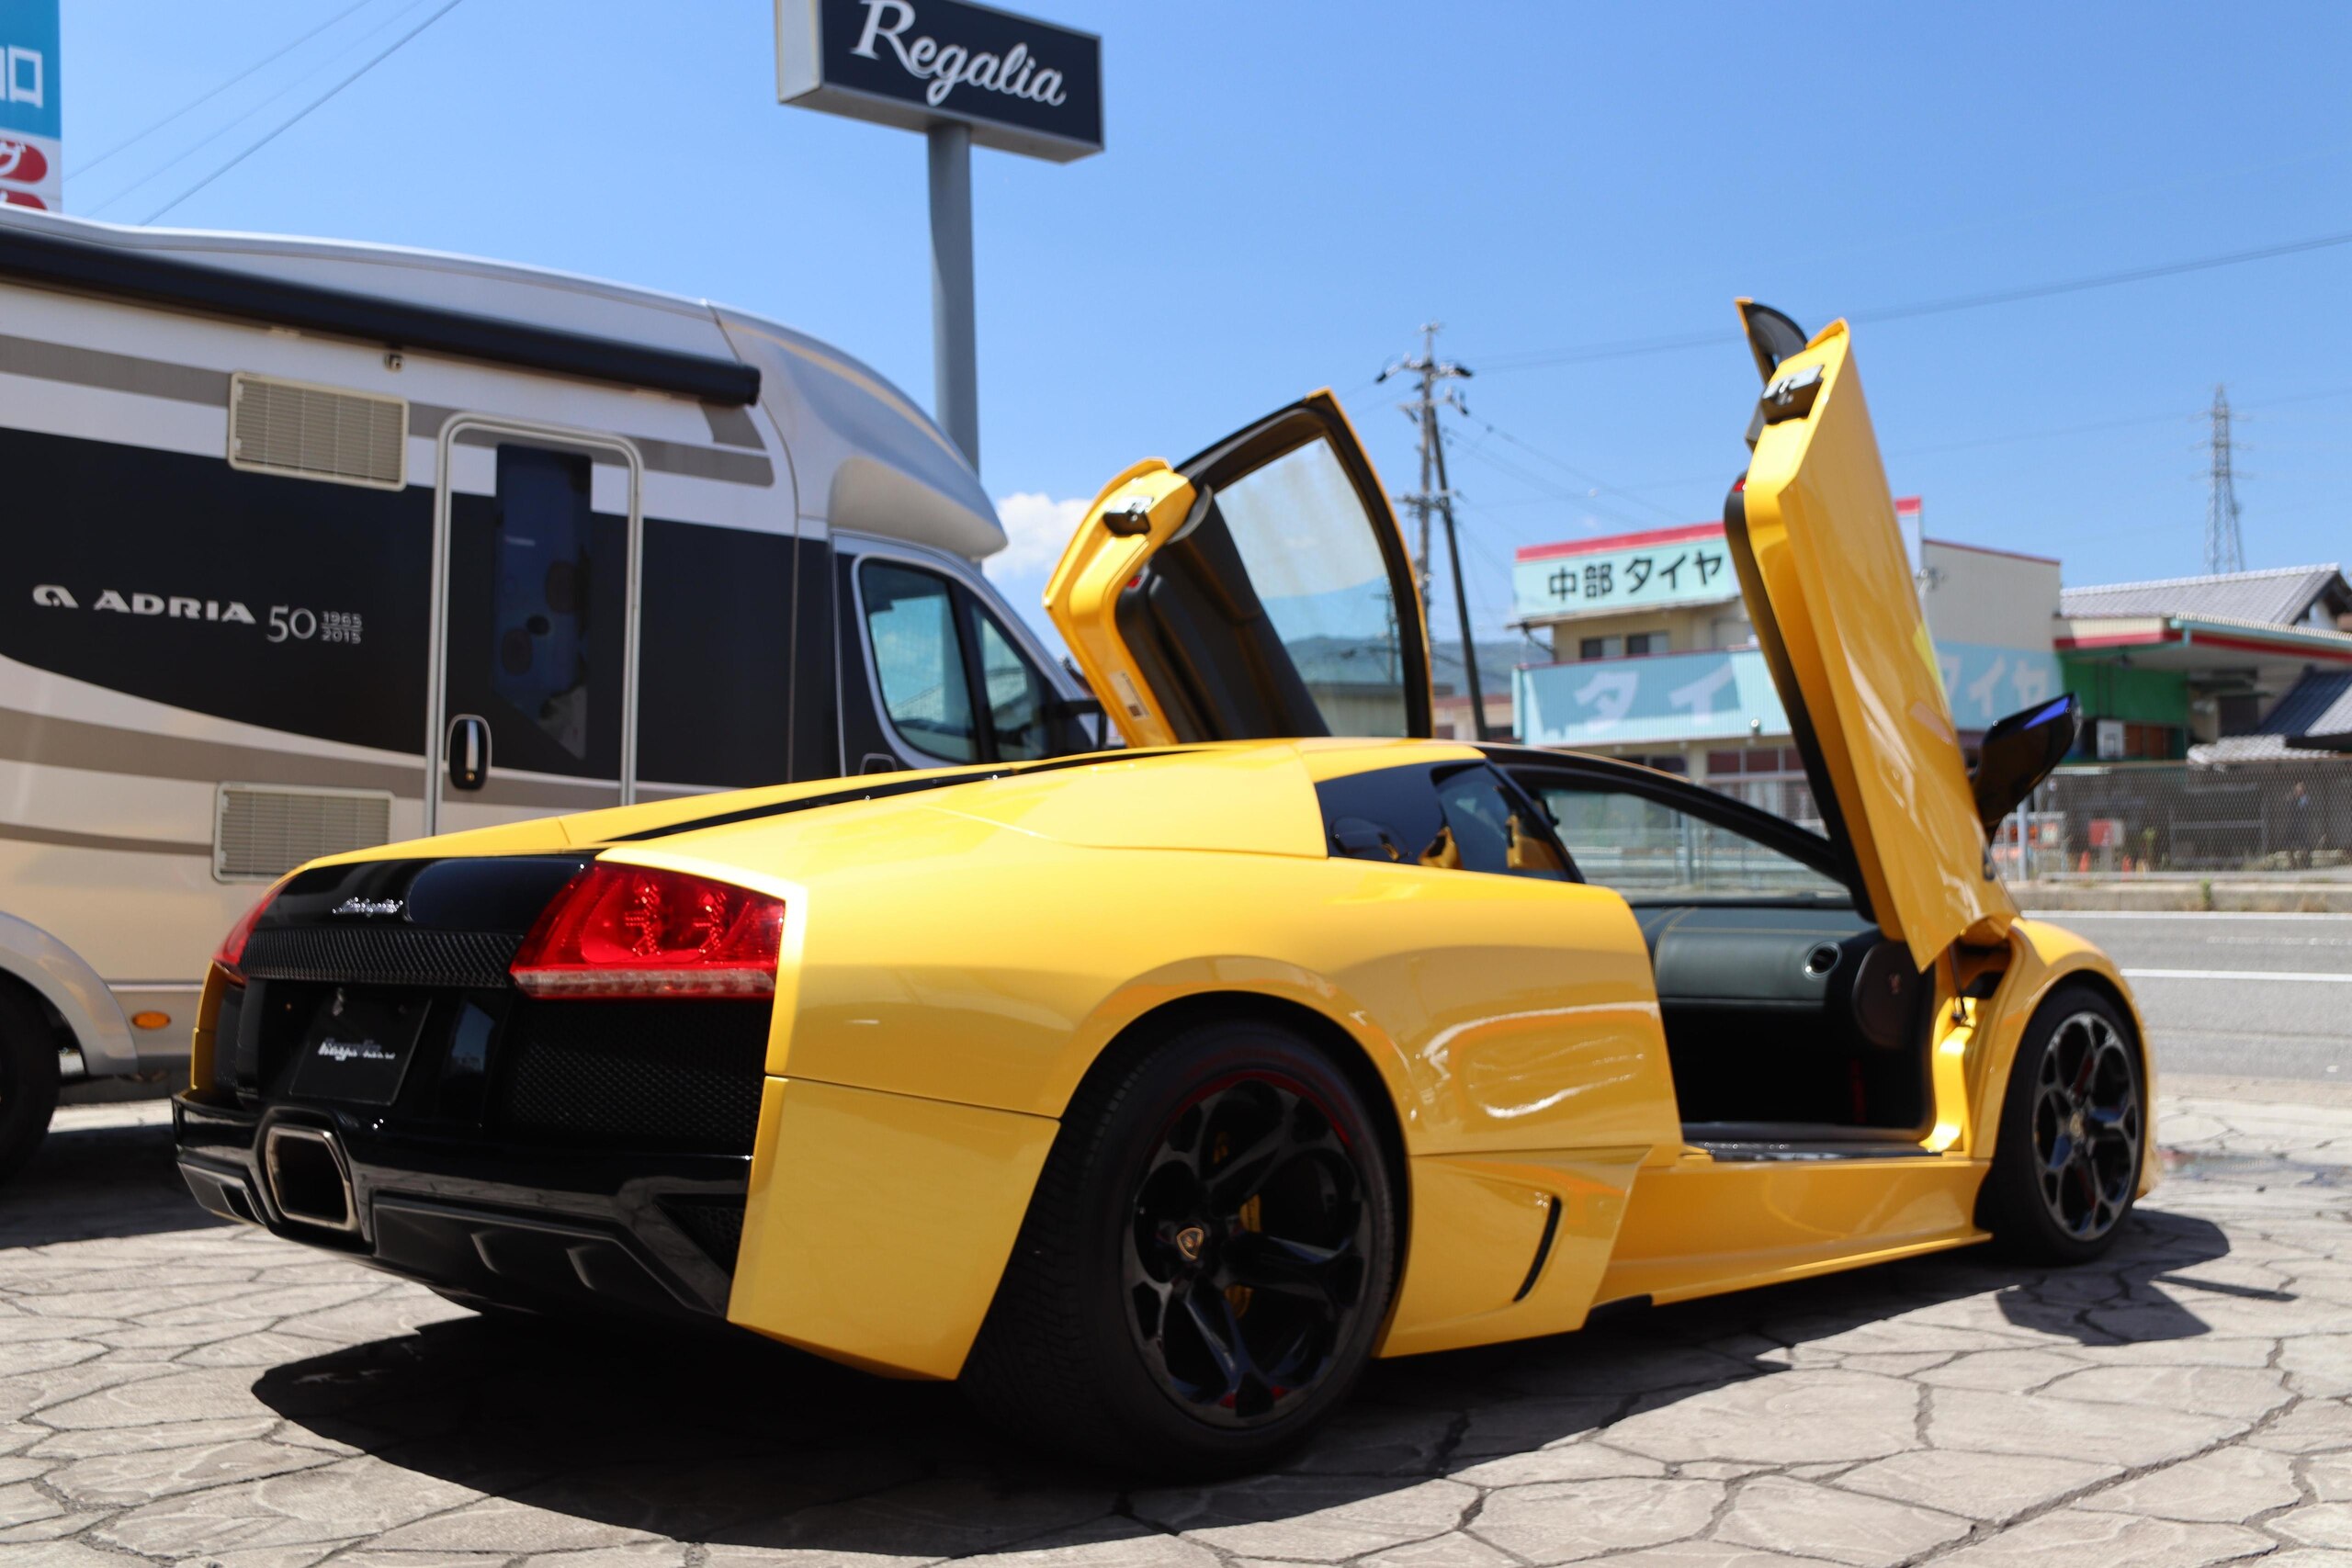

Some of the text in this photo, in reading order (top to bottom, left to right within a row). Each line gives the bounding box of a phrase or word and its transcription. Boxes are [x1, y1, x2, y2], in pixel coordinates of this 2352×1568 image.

[851, 0, 1067, 107] Regalia
[1549, 550, 1722, 601] 中部タイヤ
[94, 590, 256, 624] ADRIA
[266, 605, 317, 642] 50
[322, 611, 362, 626] 1965
[322, 627, 362, 644] 2015
